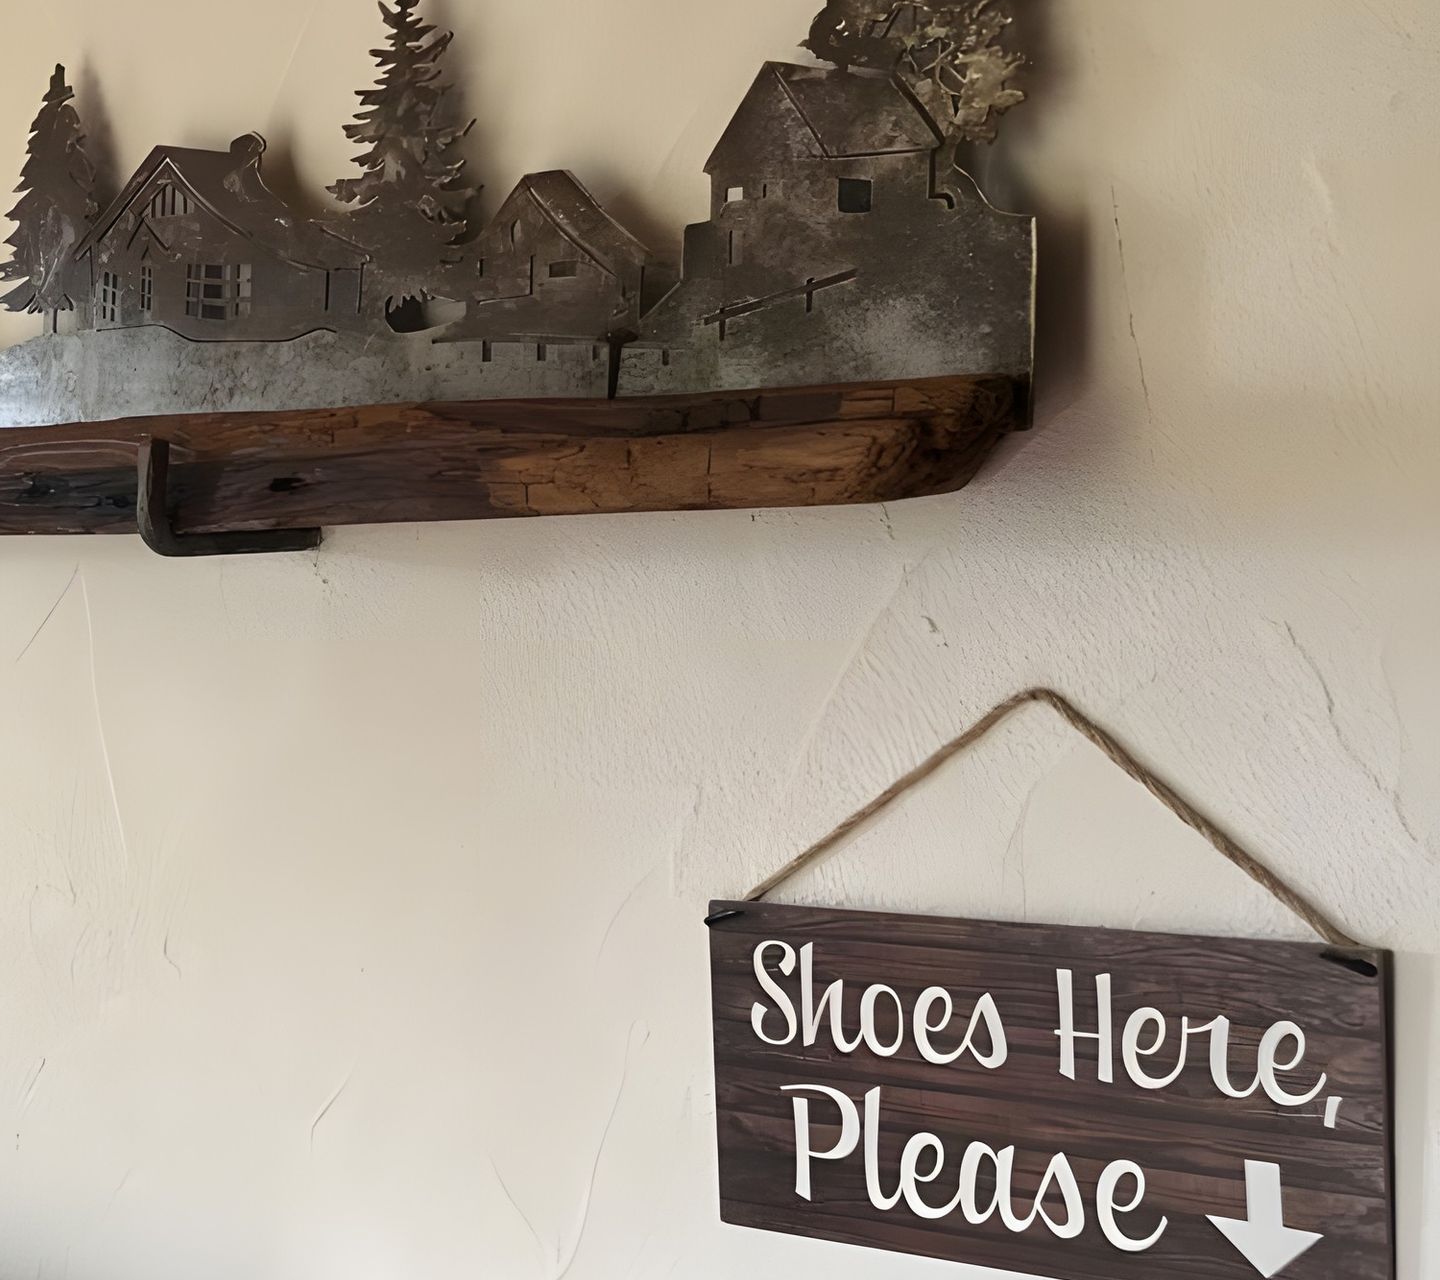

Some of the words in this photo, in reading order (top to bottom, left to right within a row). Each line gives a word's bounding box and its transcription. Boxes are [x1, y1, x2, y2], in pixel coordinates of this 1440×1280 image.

[749, 939, 1008, 1070] Shoes
[1053, 967, 1344, 1129] Here,
[779, 1082, 1169, 1253] Please
